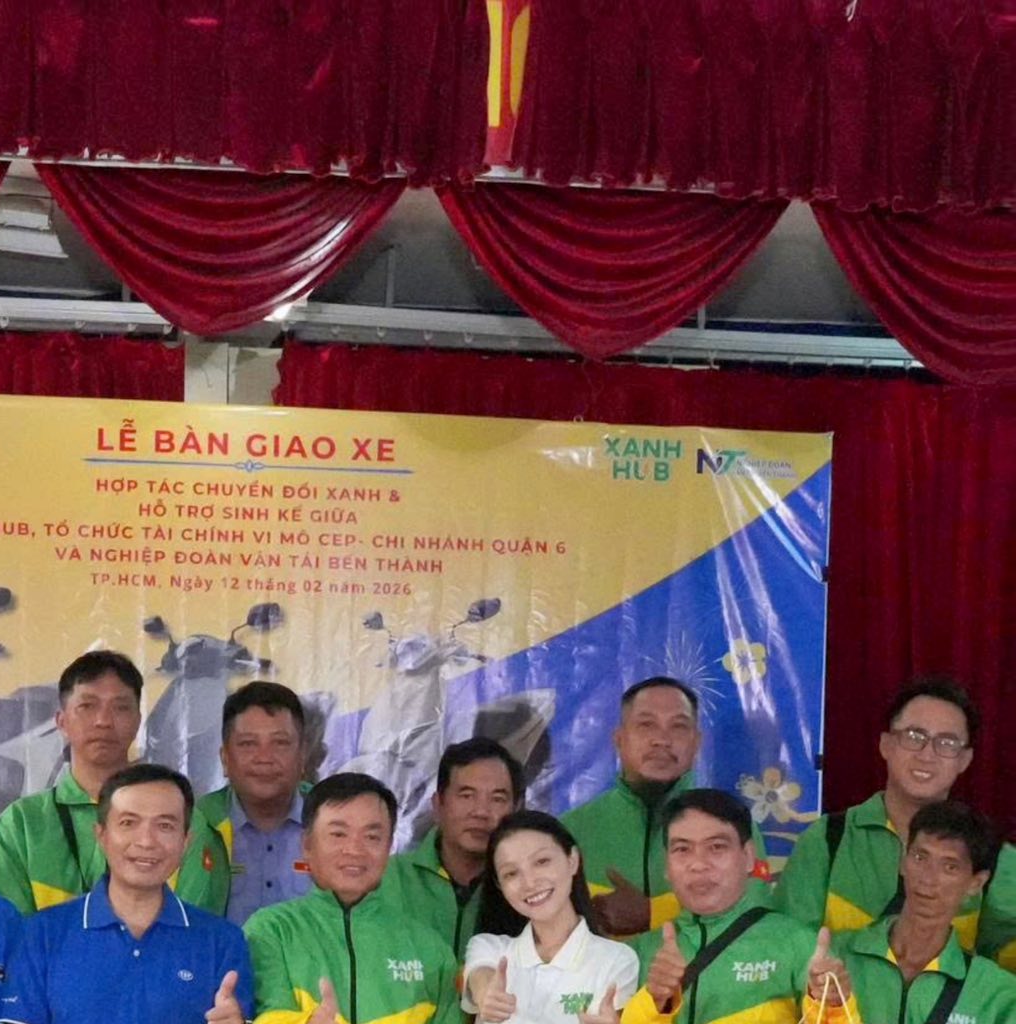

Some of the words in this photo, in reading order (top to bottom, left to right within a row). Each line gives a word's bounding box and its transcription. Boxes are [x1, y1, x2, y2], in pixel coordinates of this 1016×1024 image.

[97, 418, 137, 452] LỄ
[154, 424, 229, 455] BÀN
[246, 433, 336, 460] GIAO
[351, 437, 395, 461] XE
[604, 437, 681, 459] XANH
[95, 478, 139, 495] HỢP
[146, 477, 184, 495] TÁC
[326, 487, 381, 502] XANH
[388, 489, 400, 502] &
[138, 499, 167, 518] HỖ
[175, 504, 215, 521] TRỢ
[222, 507, 269, 521] SINH
[310, 507, 358, 525] GIỮA
[77, 521, 134, 540] CHỨC
[143, 524, 172, 541] TÀI
[180, 524, 244, 543] CHÍNH
[253, 531, 271, 544] VI
[279, 530, 310, 546] MÔ
[371, 534, 404, 550] CHI
[413, 536, 484, 552] NHÁNH
[491, 538, 548, 556] QUẬN
[555, 541, 566, 555] 6
[55, 545, 82, 561] VÀ
[90, 546, 166, 567] NGHIỆP
[174, 548, 232, 566] ĐOÀN
[376, 557, 443, 574] THÀNH
[169, 575, 214, 593] Ngày
[222, 577, 239, 591] 12
[246, 578, 296, 594] tháng
[303, 579, 323, 593] 02
[372, 581, 412, 596] 2026
[392, 969, 424, 981] HUB
[731, 960, 776, 972] XANH
[736, 971, 769, 982] HUB
